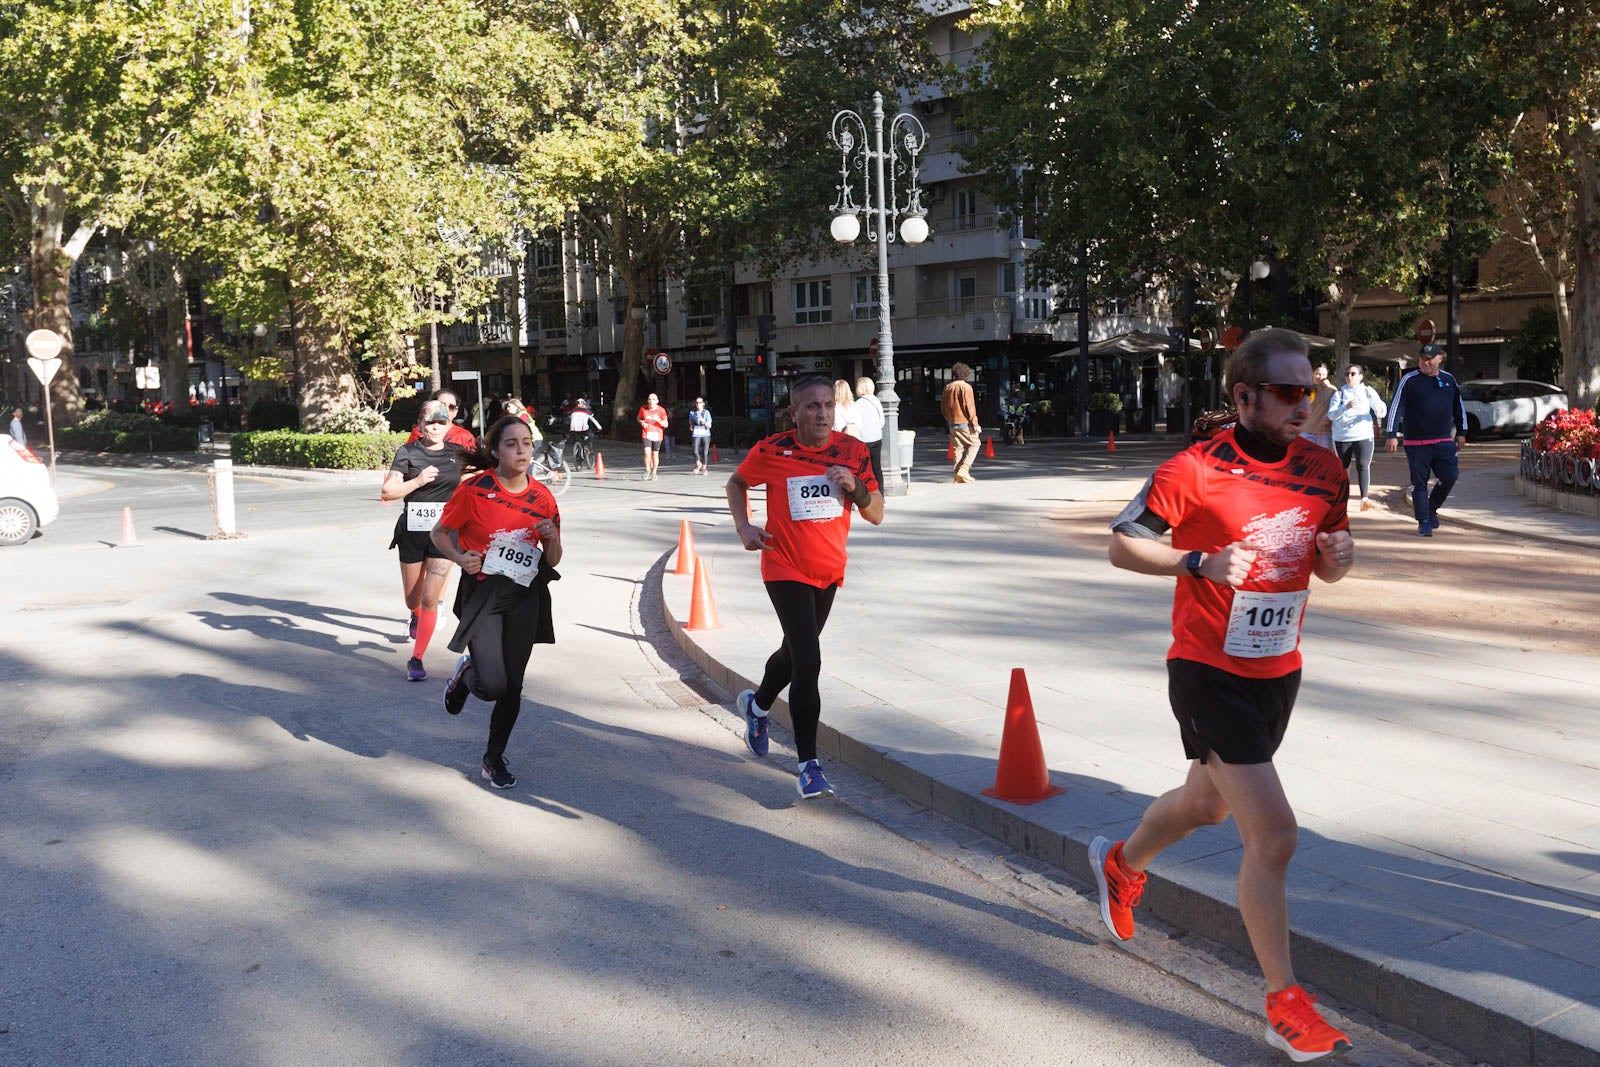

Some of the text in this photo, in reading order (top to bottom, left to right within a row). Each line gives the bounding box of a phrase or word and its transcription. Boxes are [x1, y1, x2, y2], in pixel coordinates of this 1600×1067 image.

[801, 484, 830, 498] 820
[416, 508, 437, 518] 438
[498, 546, 533, 567] 1895
[1246, 606, 1295, 627] 1019
